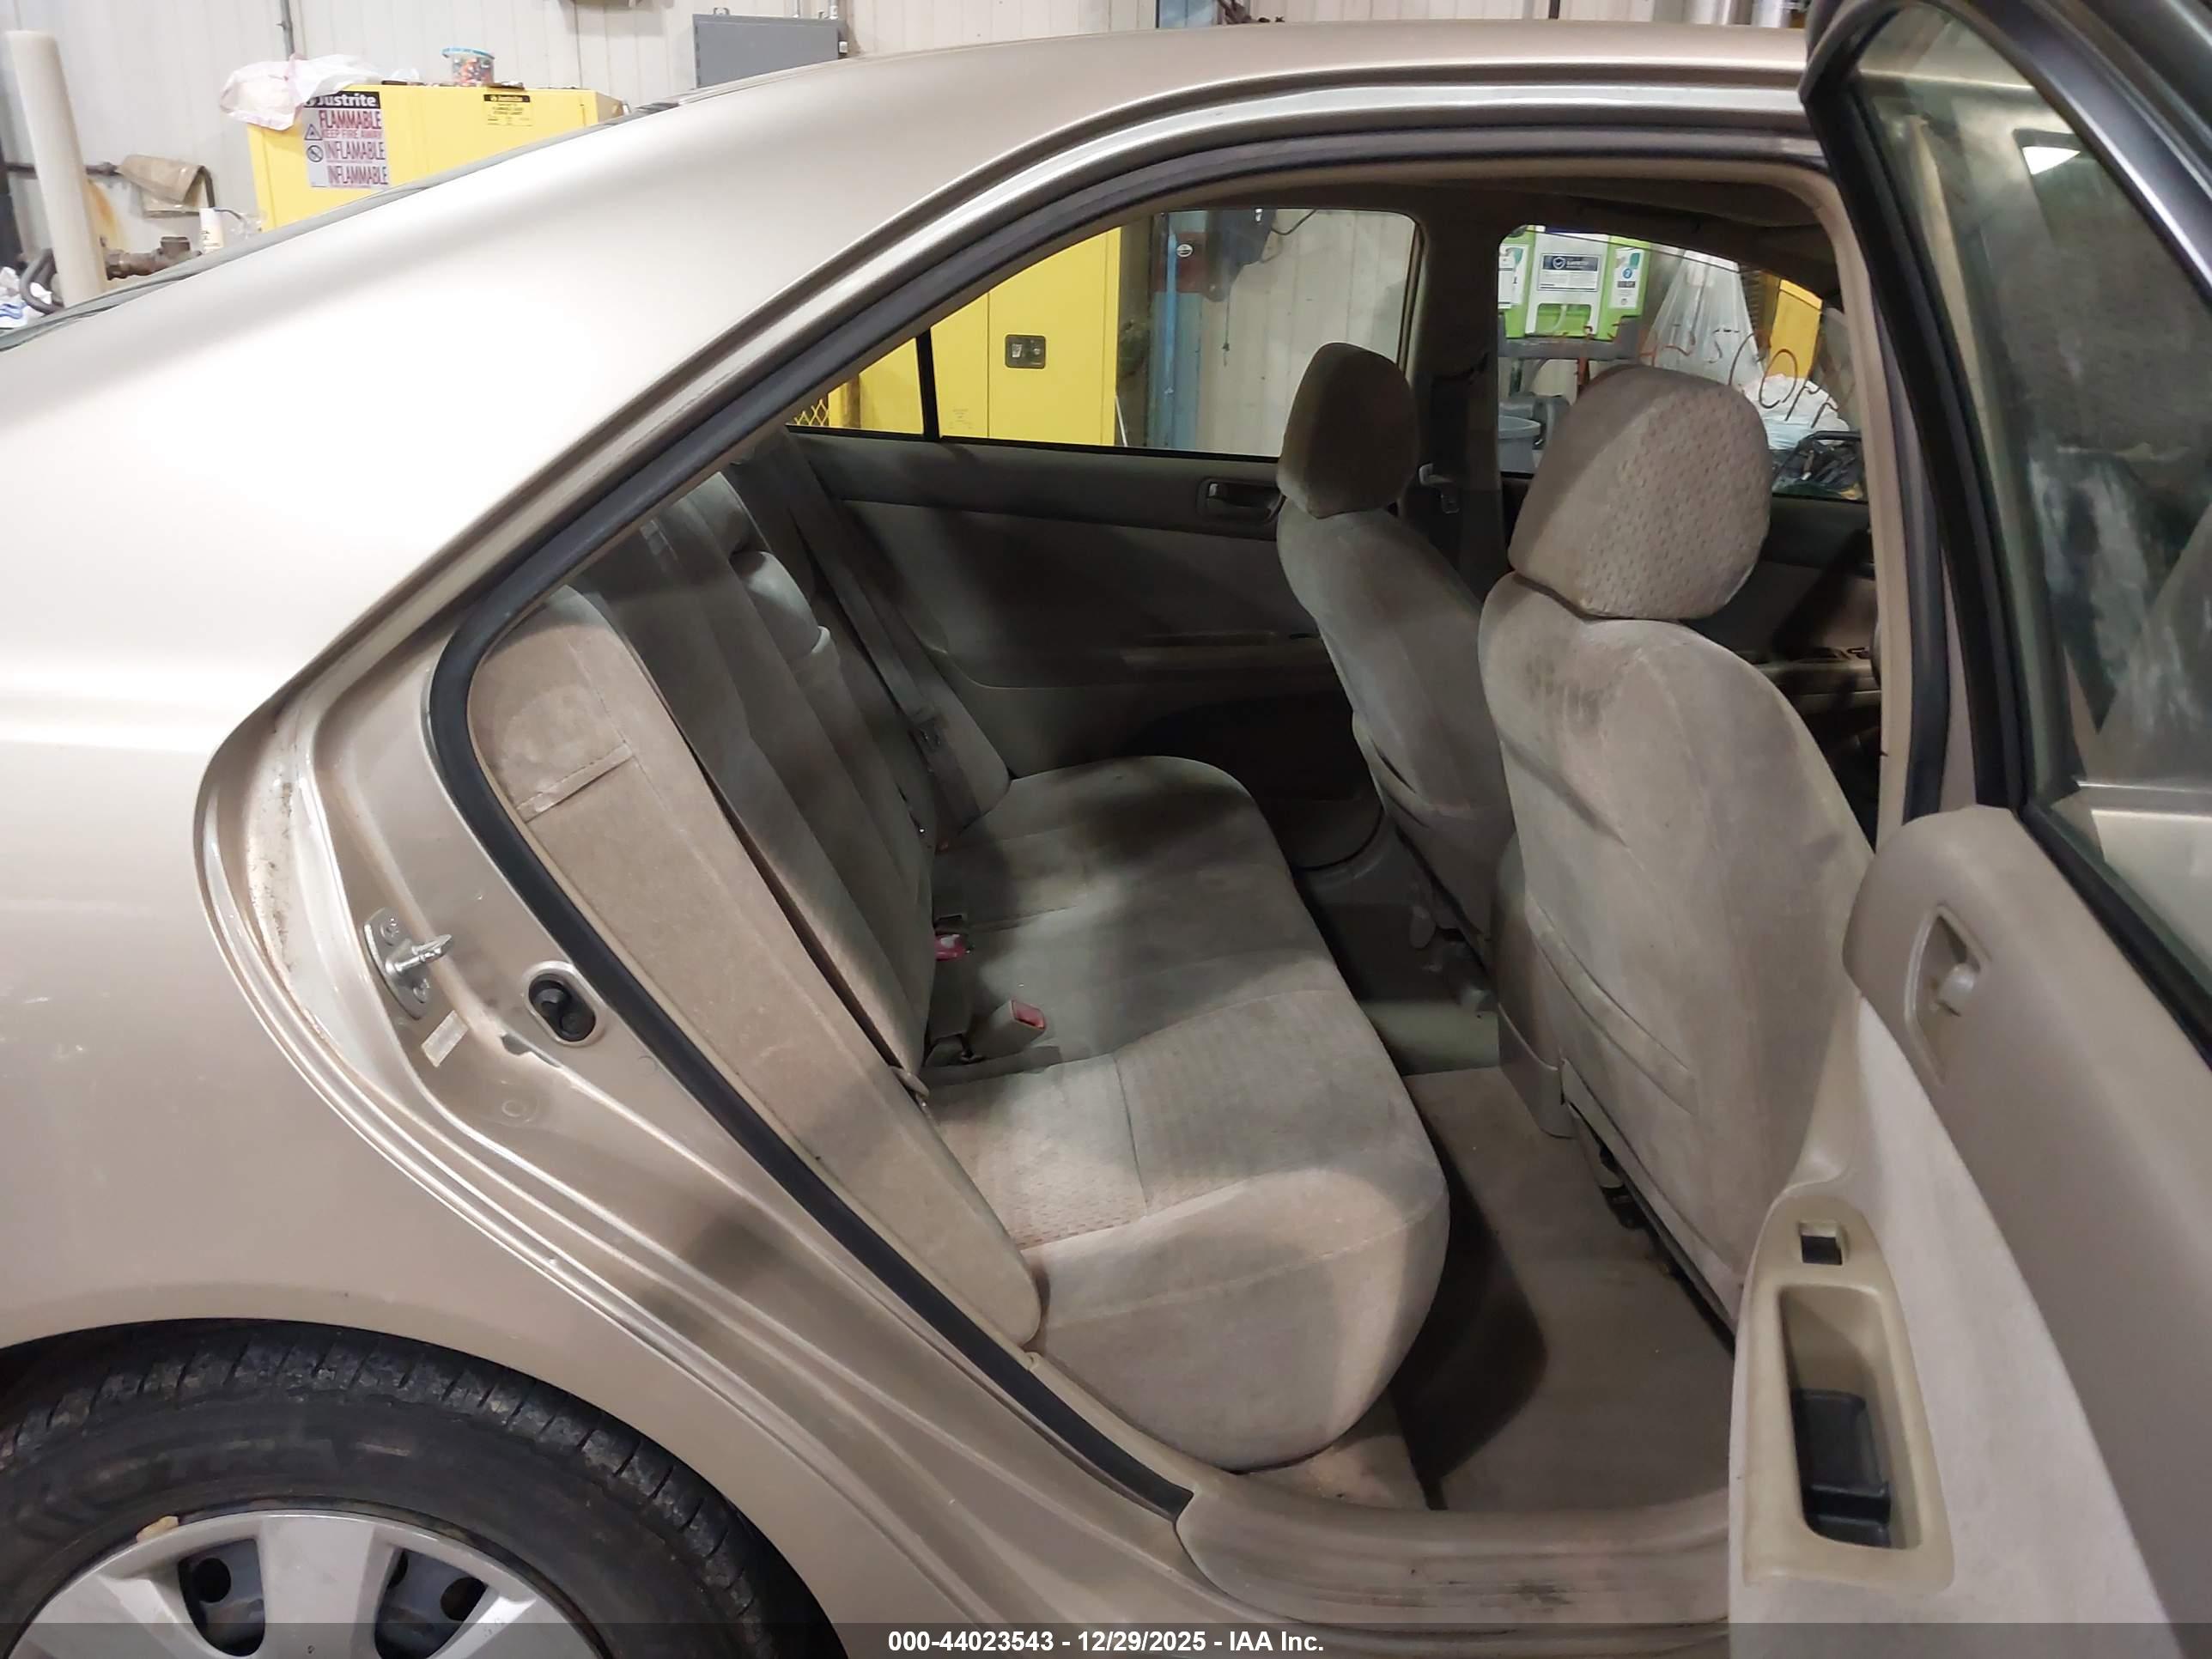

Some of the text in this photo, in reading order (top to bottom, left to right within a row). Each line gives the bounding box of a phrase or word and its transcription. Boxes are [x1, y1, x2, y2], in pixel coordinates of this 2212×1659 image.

[319, 110, 381, 129] FLAMMABLE
[325, 140, 386, 160] INFLAMABLE
[327, 165, 389, 185] INFLAMMABLE
